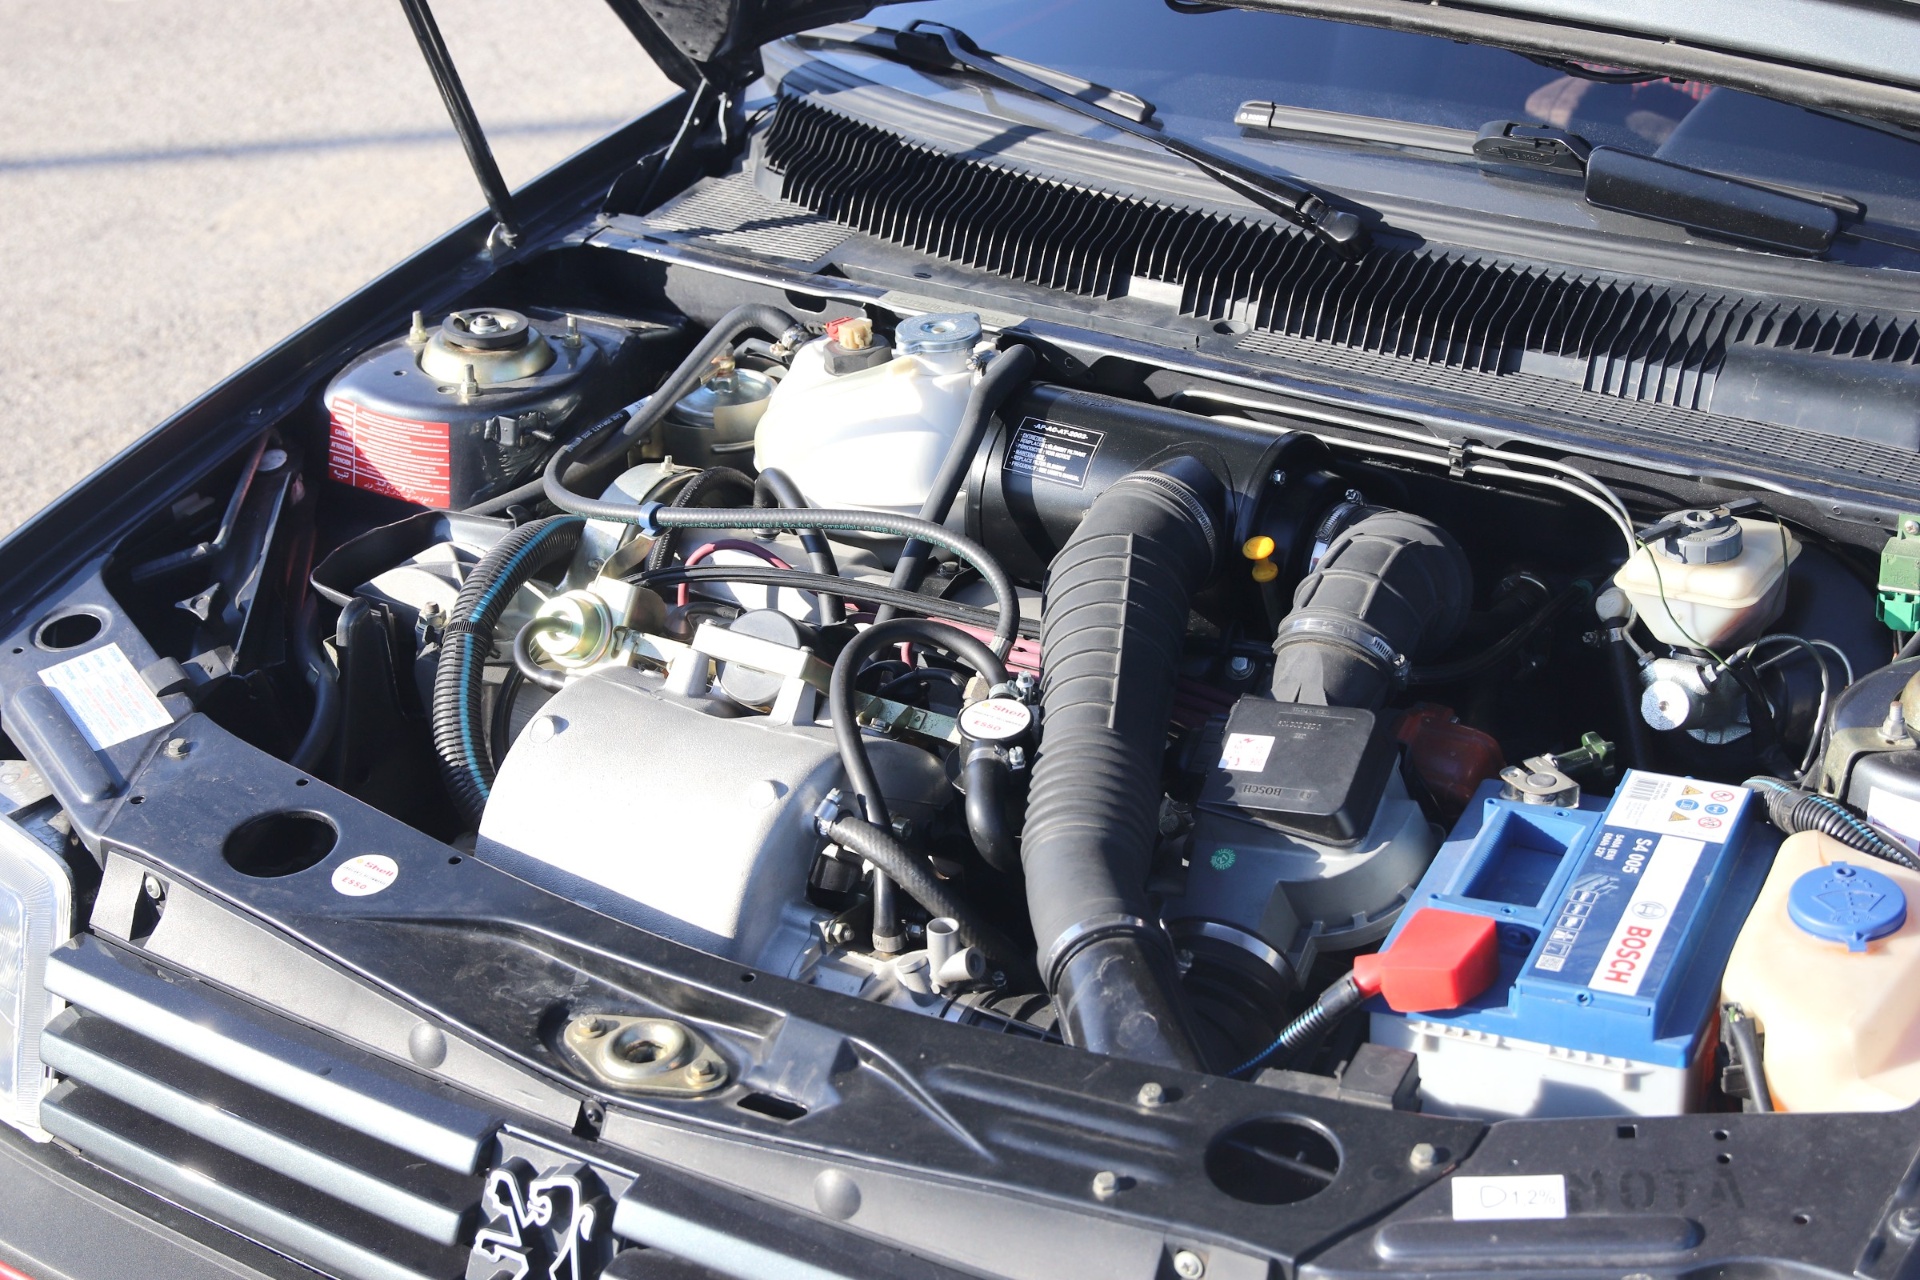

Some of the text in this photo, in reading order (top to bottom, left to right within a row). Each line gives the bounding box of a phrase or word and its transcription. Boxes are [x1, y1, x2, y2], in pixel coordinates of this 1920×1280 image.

[993, 704, 1026, 718] Shell
[974, 720, 1001, 731] ESSO
[1243, 784, 1282, 796] BOSCH
[1632, 837, 1653, 853] S4
[364, 861, 394, 877] Shell
[1621, 853, 1646, 874] 005
[341, 876, 367, 890] ESSO
[1604, 925, 1653, 984] BOSCH
